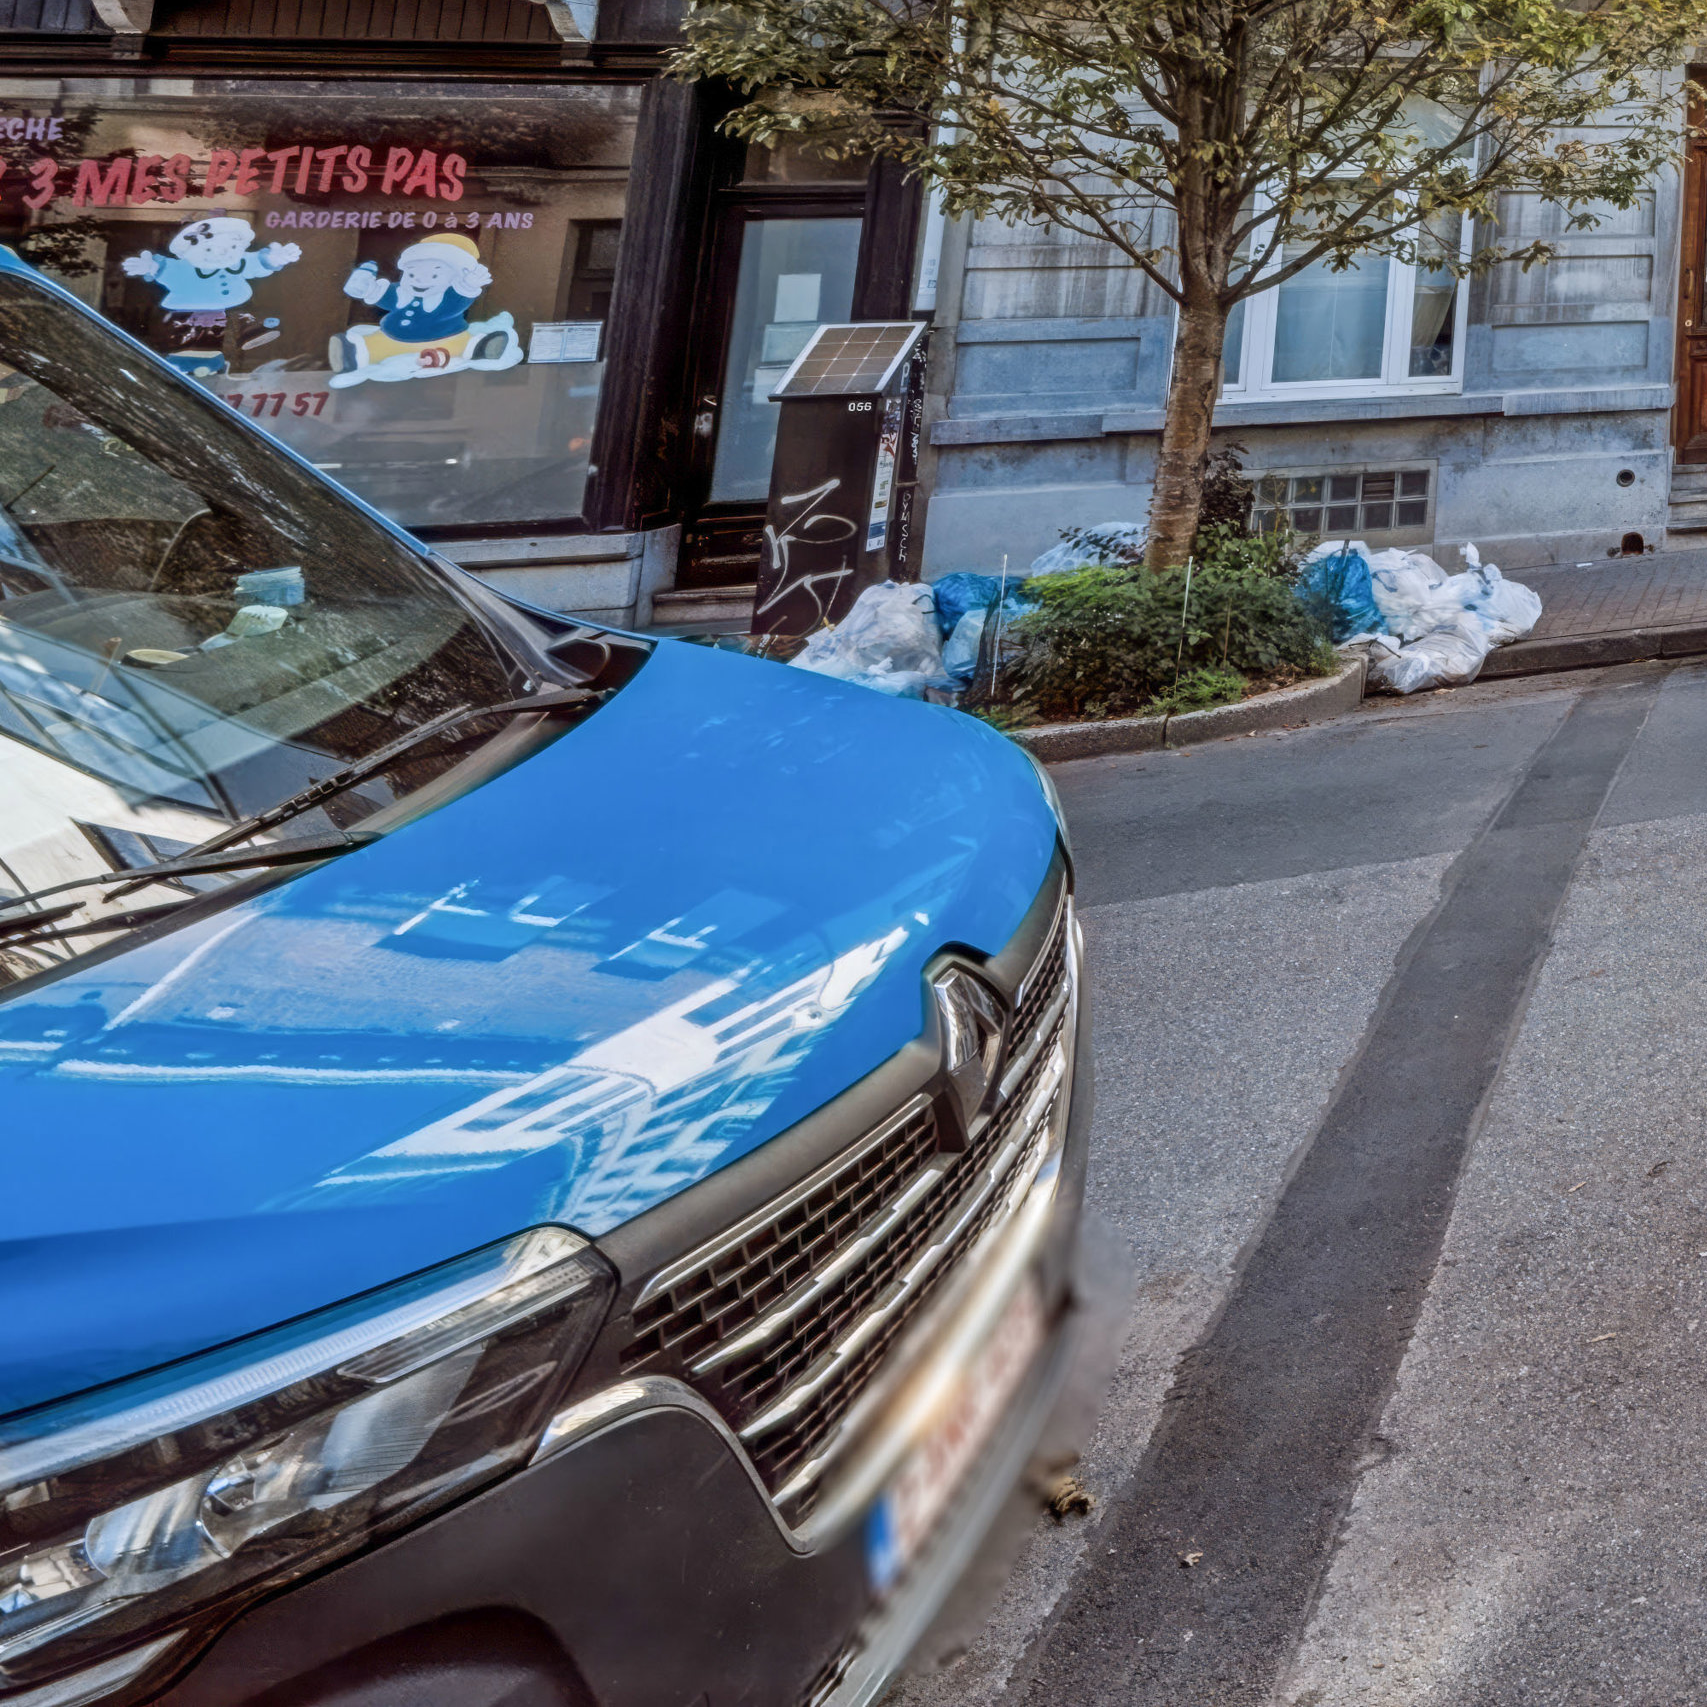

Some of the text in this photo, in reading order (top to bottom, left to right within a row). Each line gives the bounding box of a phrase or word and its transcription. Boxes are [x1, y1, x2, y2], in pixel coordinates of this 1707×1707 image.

[22, 157, 59, 210] 3
[71, 153, 192, 208] MES
[201, 145, 372, 199] PETITS
[381, 146, 467, 202] PAS
[265, 211, 382, 229] GARDERIE
[388, 211, 417, 229] DE
[444, 214, 459, 229] à
[465, 212, 480, 229] 3
[488, 212, 535, 230] ANS
[251, 393, 286, 417] 77
[292, 392, 330, 417] 57
